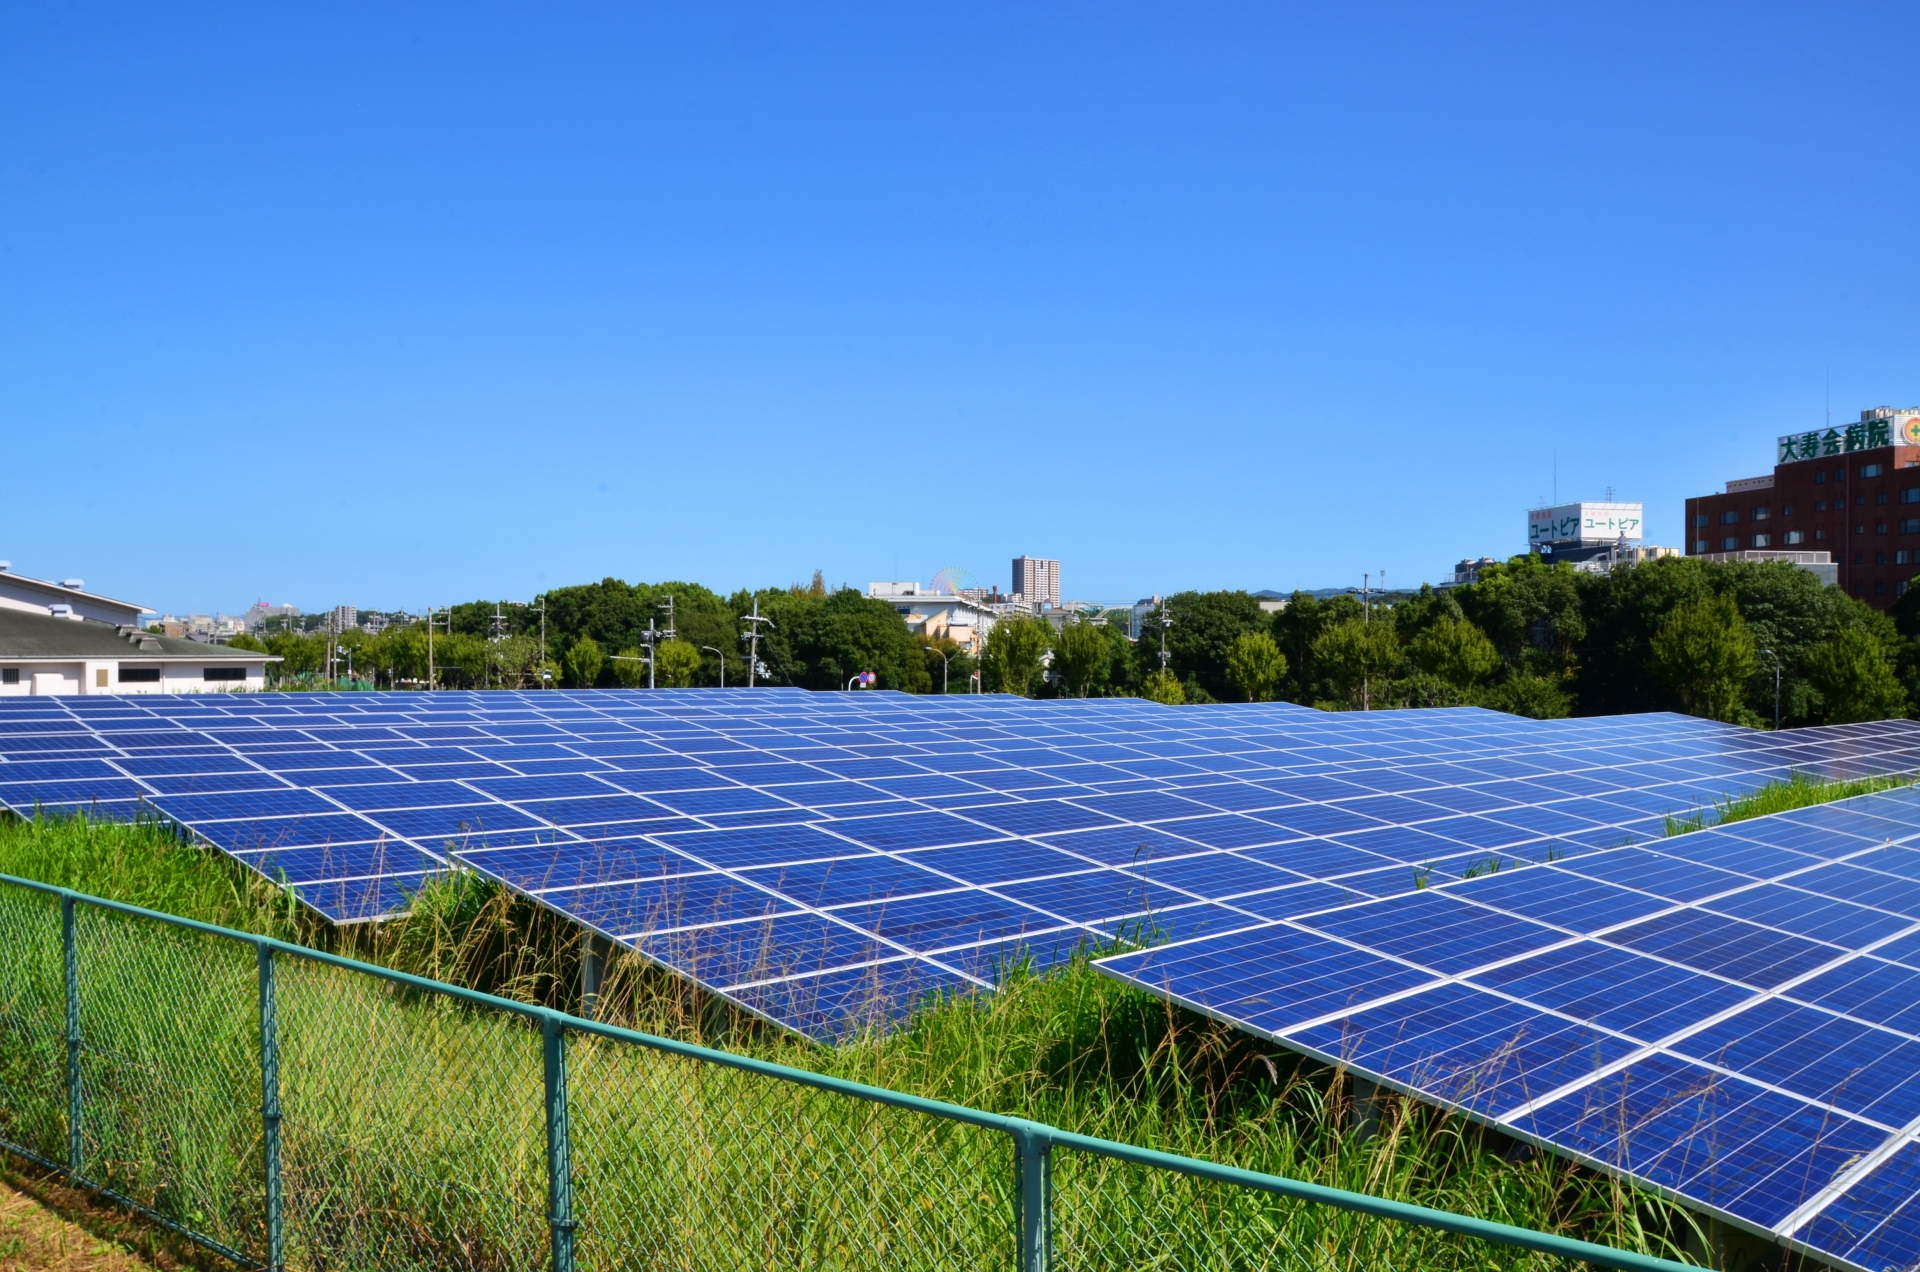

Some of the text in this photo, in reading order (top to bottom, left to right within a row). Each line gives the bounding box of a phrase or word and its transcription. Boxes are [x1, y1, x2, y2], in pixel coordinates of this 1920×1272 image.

[1781, 420, 1889, 462] 大寿会病院
[1531, 517, 1580, 539] ユートピア
[1584, 518, 1639, 530] ユートピア
